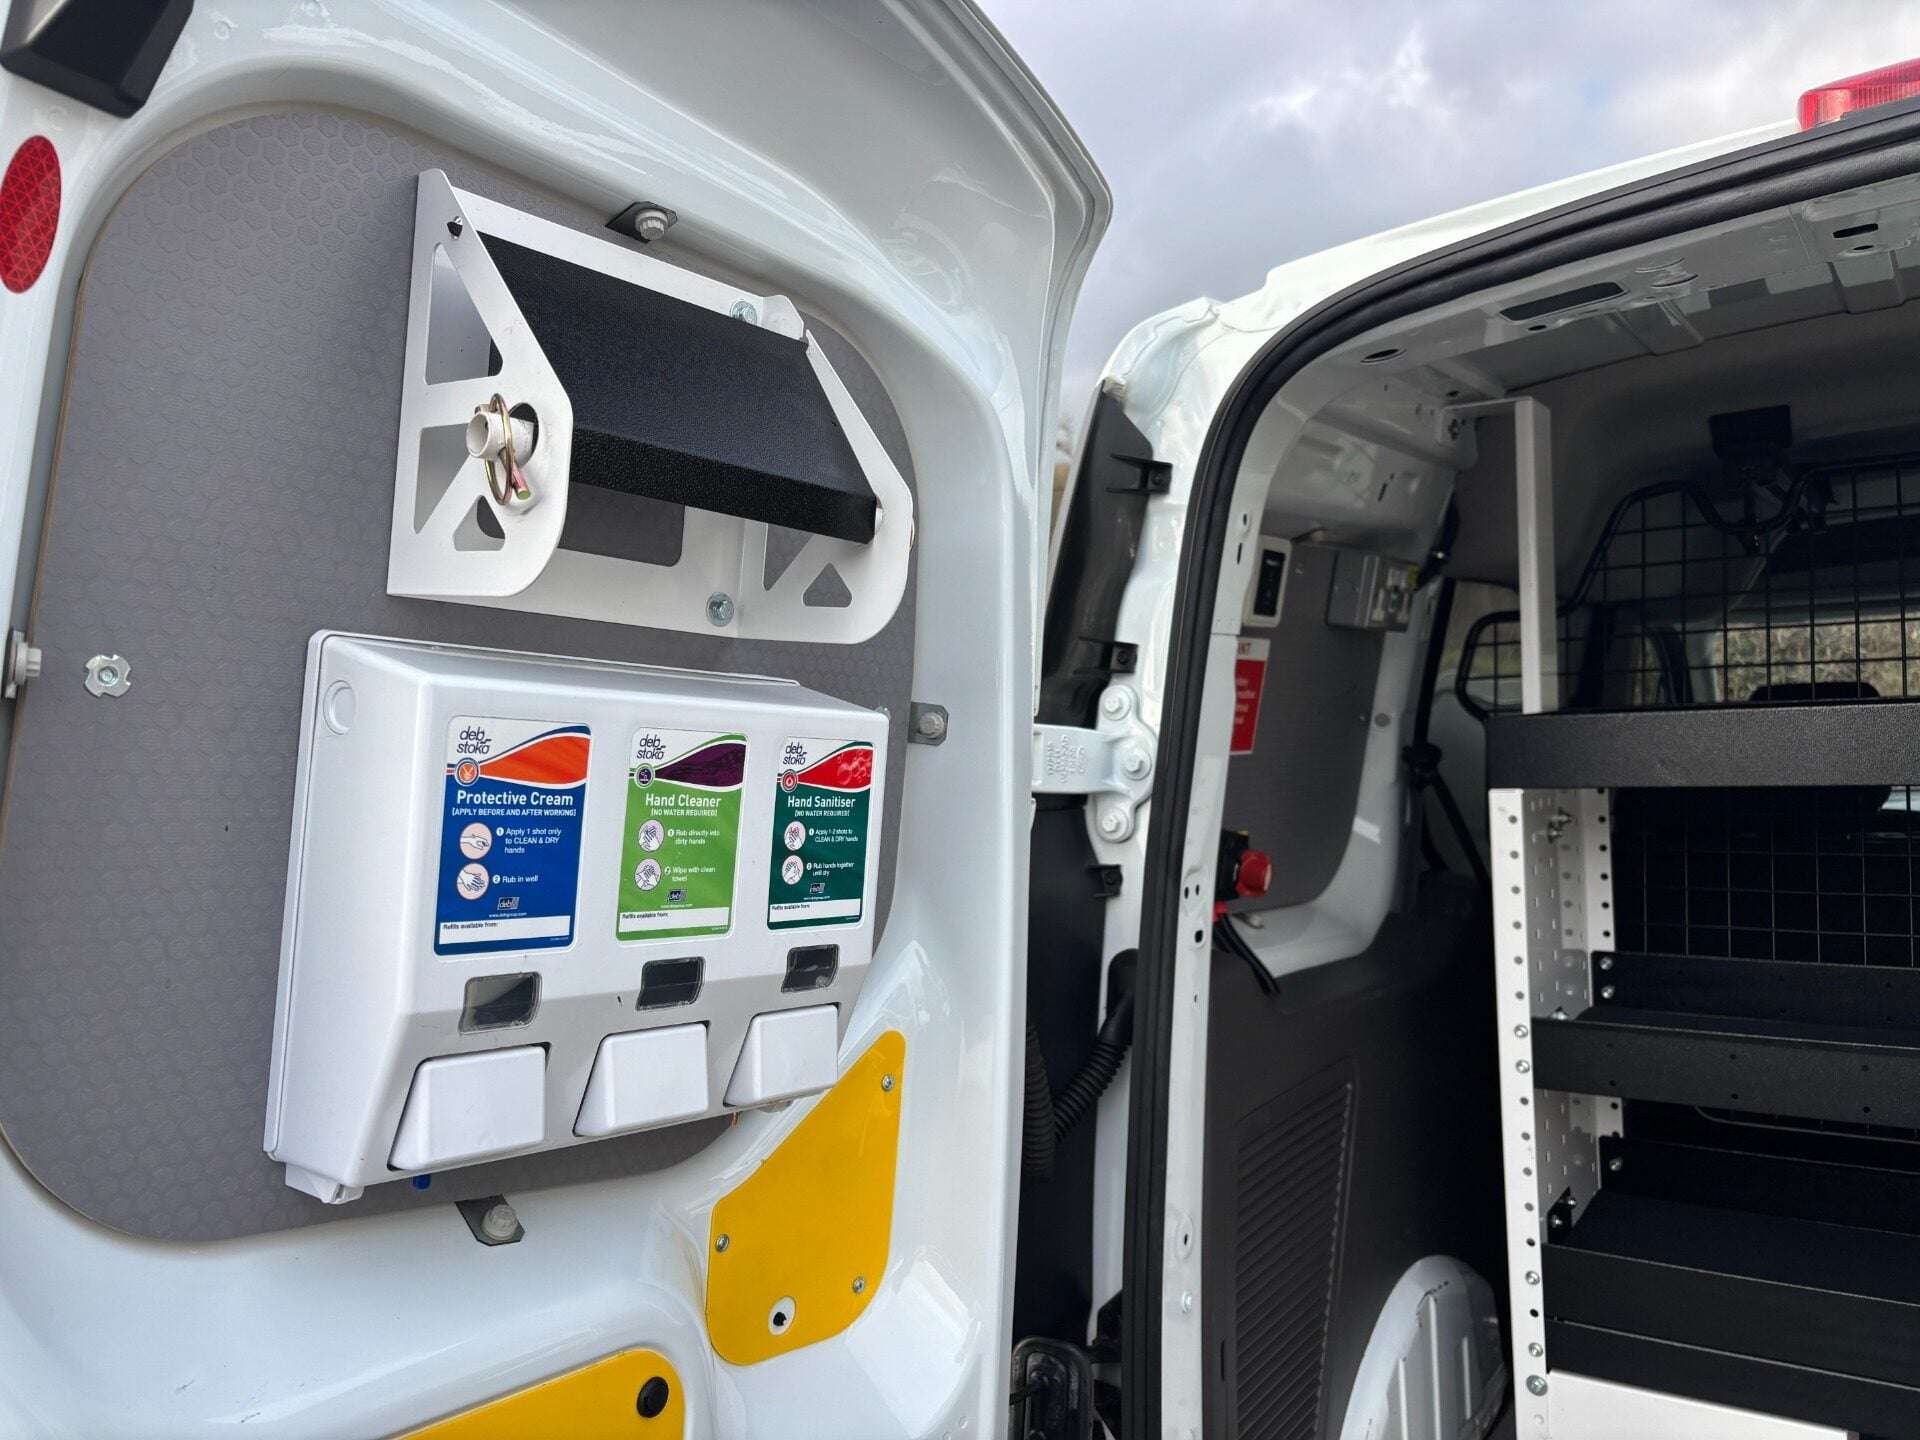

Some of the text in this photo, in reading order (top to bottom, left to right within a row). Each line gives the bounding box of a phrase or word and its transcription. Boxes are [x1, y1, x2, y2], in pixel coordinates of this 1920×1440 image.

[460, 726, 485, 740] deb
[639, 734, 661, 748] deb
[785, 742, 802, 755] deb
[457, 791, 573, 806] Protective Cream
[645, 793, 722, 807] Hand Cleaner
[787, 795, 856, 808] Hand Sanitiser
[478, 808, 505, 816] BEFORE
[506, 808, 520, 816] AND
[505, 828, 525, 836] Apply
[548, 828, 562, 836] only
[513, 837, 537, 845] CLEAN
[502, 876, 516, 884] Rub
[525, 875, 539, 883] well
